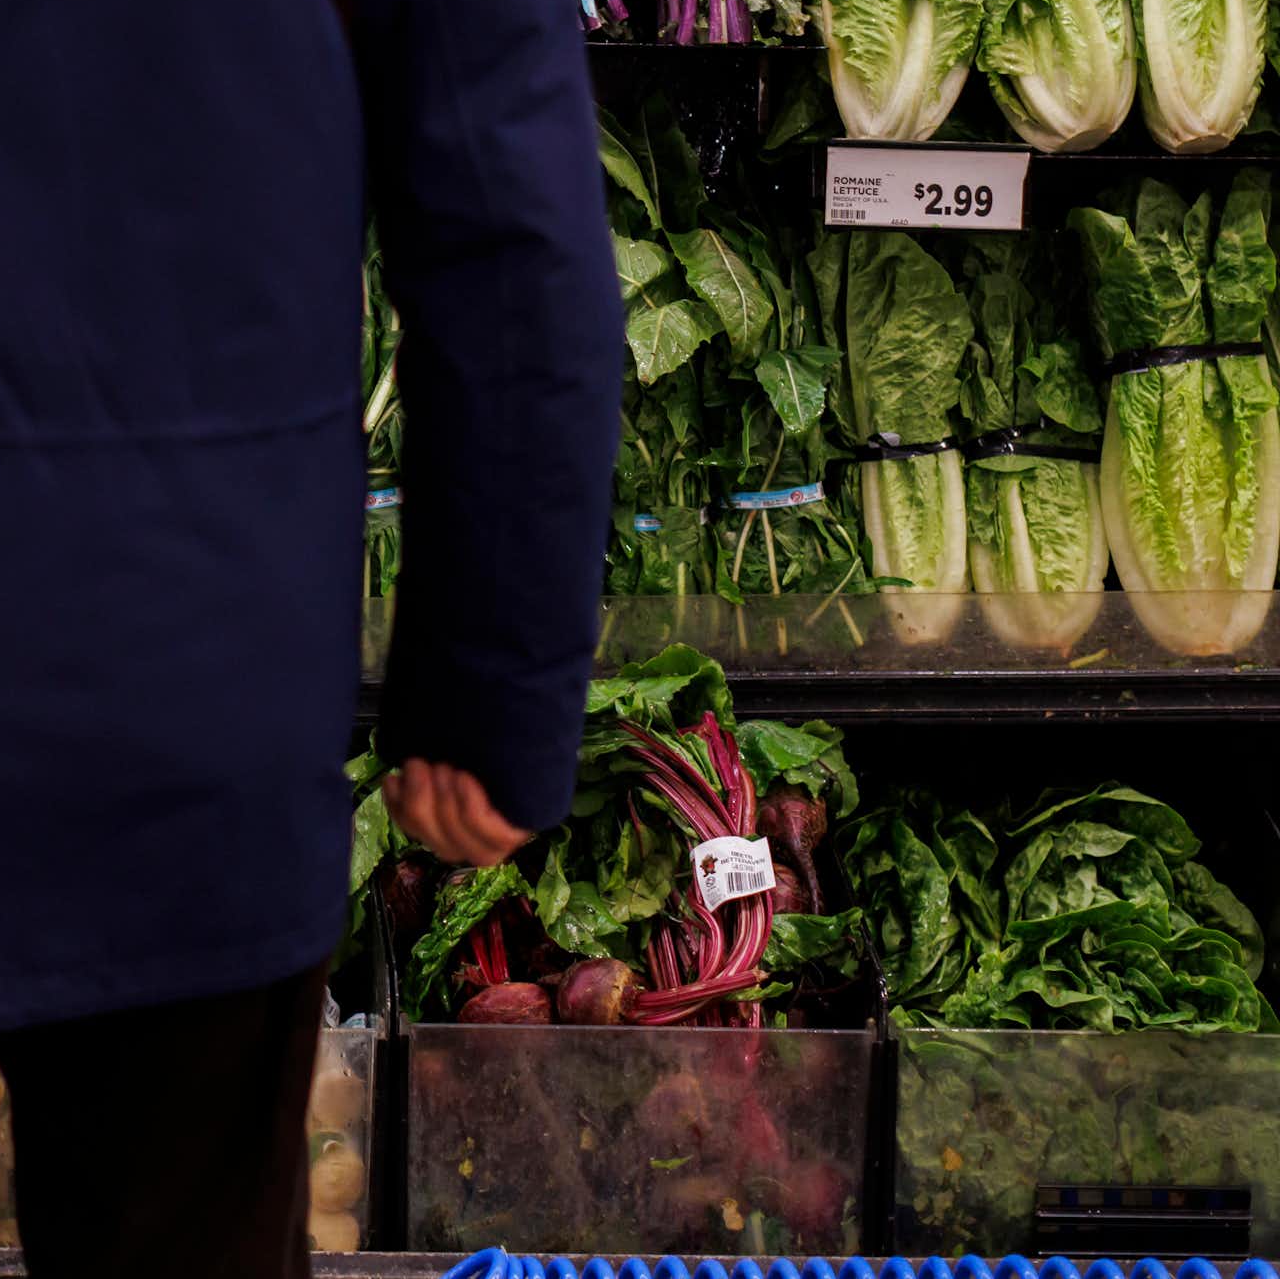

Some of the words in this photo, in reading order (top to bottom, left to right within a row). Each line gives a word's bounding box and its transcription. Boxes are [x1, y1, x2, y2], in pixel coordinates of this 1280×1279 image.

[833, 176, 882, 186] ROMAINE
[833, 186, 880, 196] LETTUCE
[914, 182, 993, 217] $2.99
